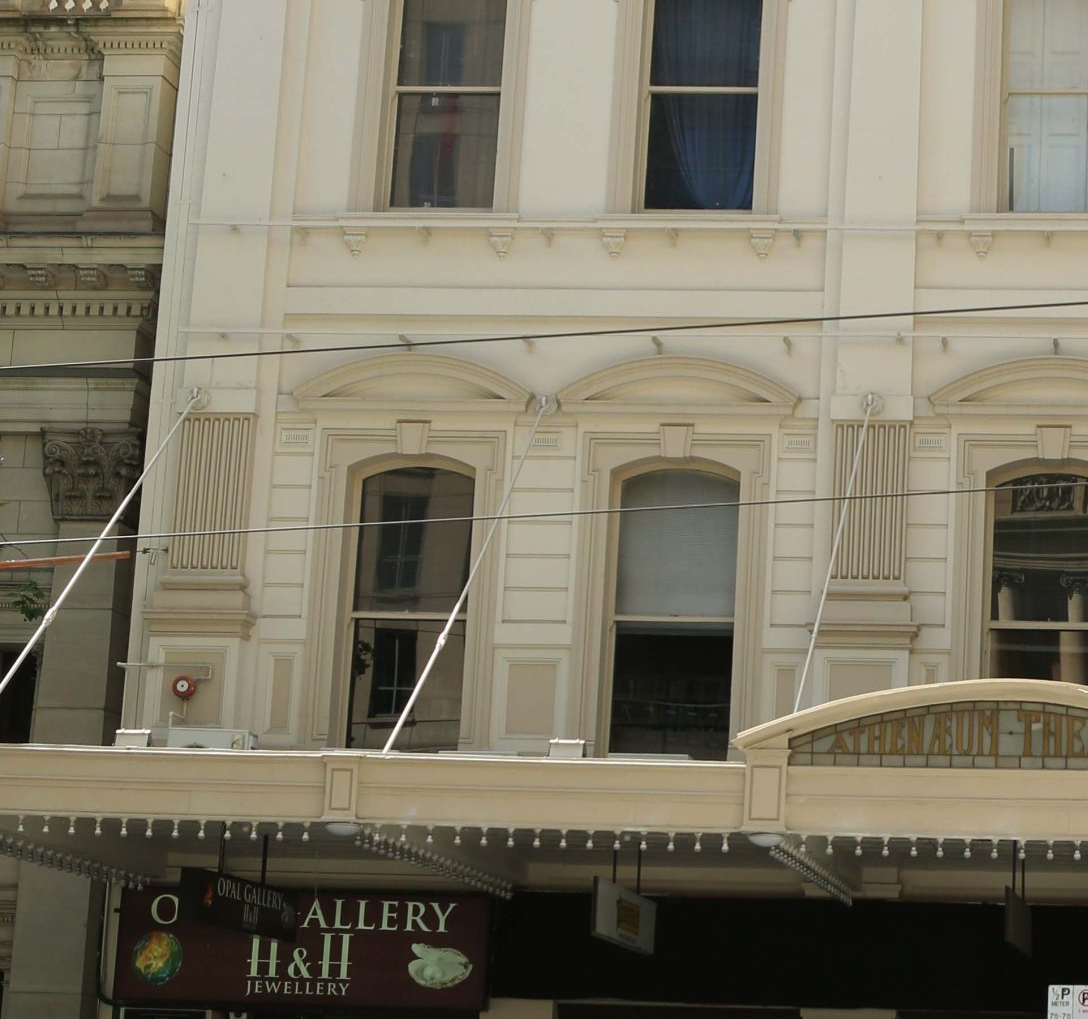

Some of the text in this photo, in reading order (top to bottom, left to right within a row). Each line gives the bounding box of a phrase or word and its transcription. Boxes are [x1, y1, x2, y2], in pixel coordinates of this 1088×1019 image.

[827, 709, 999, 755] ATHENÆUM
[217, 877, 284, 909] OPAL GALLERY
[298, 898, 458, 932] ALLERY
[245, 980, 350, 996] JEWELLERY
